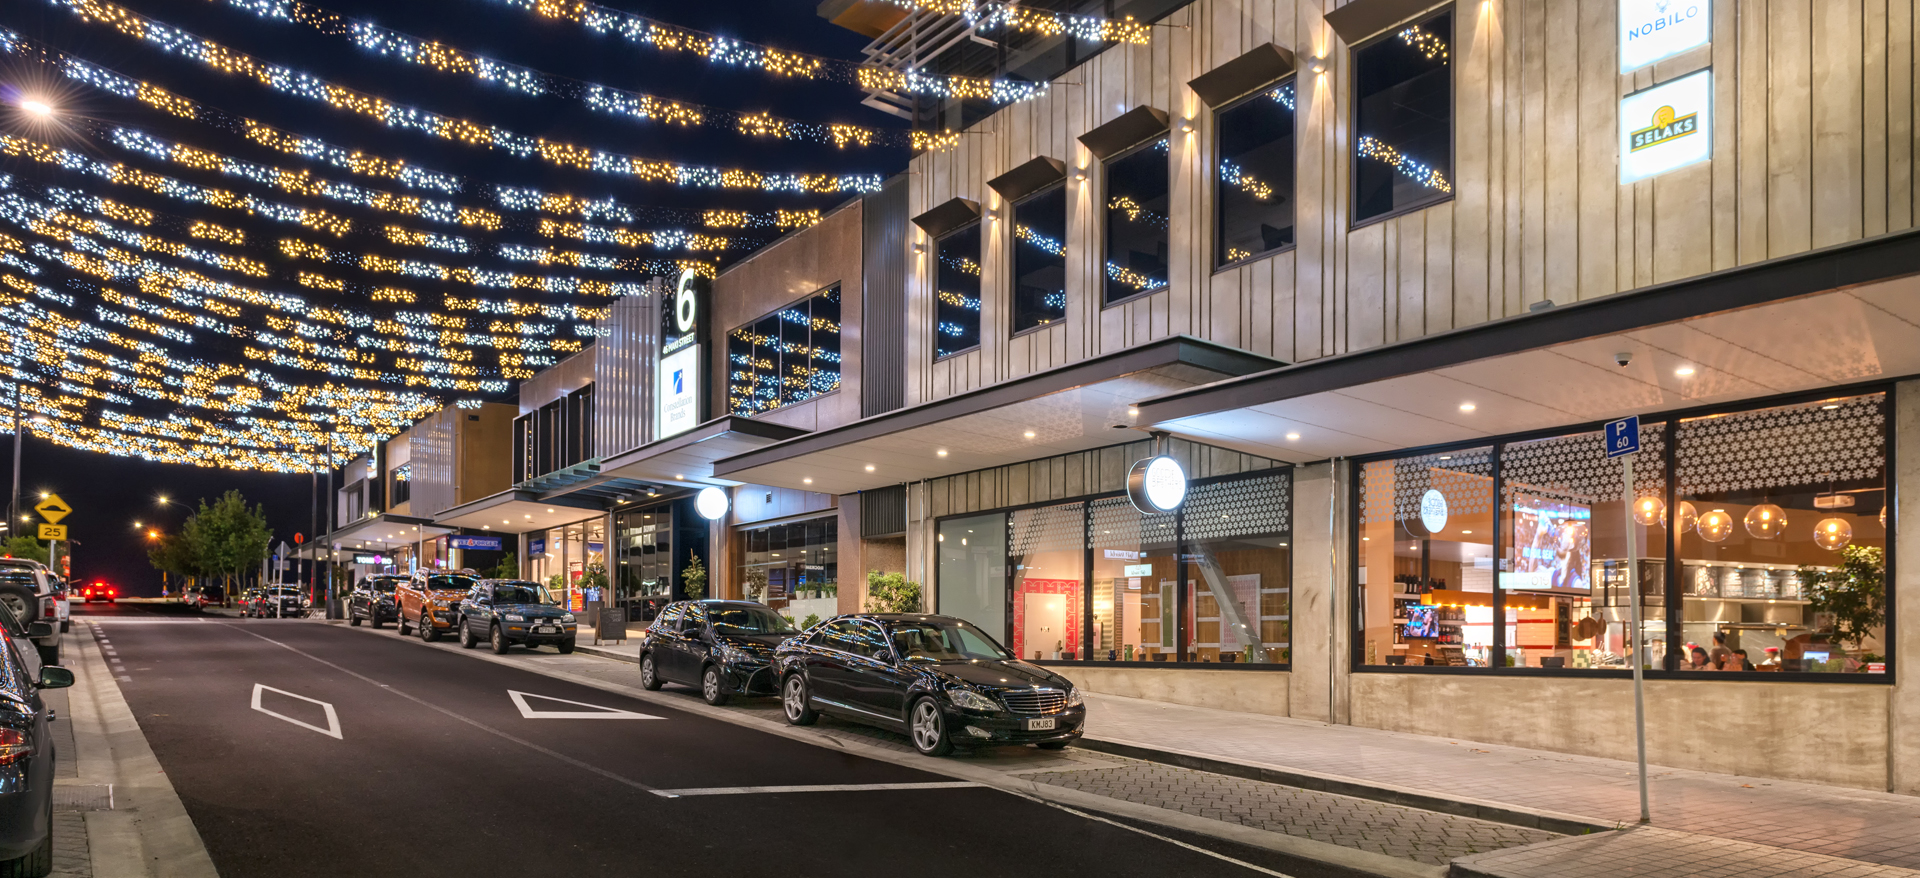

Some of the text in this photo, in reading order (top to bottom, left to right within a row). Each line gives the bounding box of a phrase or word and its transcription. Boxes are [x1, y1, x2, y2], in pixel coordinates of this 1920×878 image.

[1628, 5, 1698, 41] NOBILO
[1635, 119, 1693, 147] SELAKS
[676, 267, 696, 333] 6
[679, 332, 695, 348] STREET
[663, 395, 693, 413] Constellation
[670, 408, 686, 422] Brands
[1615, 421, 1627, 436] P
[1616, 436, 1629, 449] 60
[44, 527, 61, 537] 25
[1031, 719, 1053, 729] KMJ83
